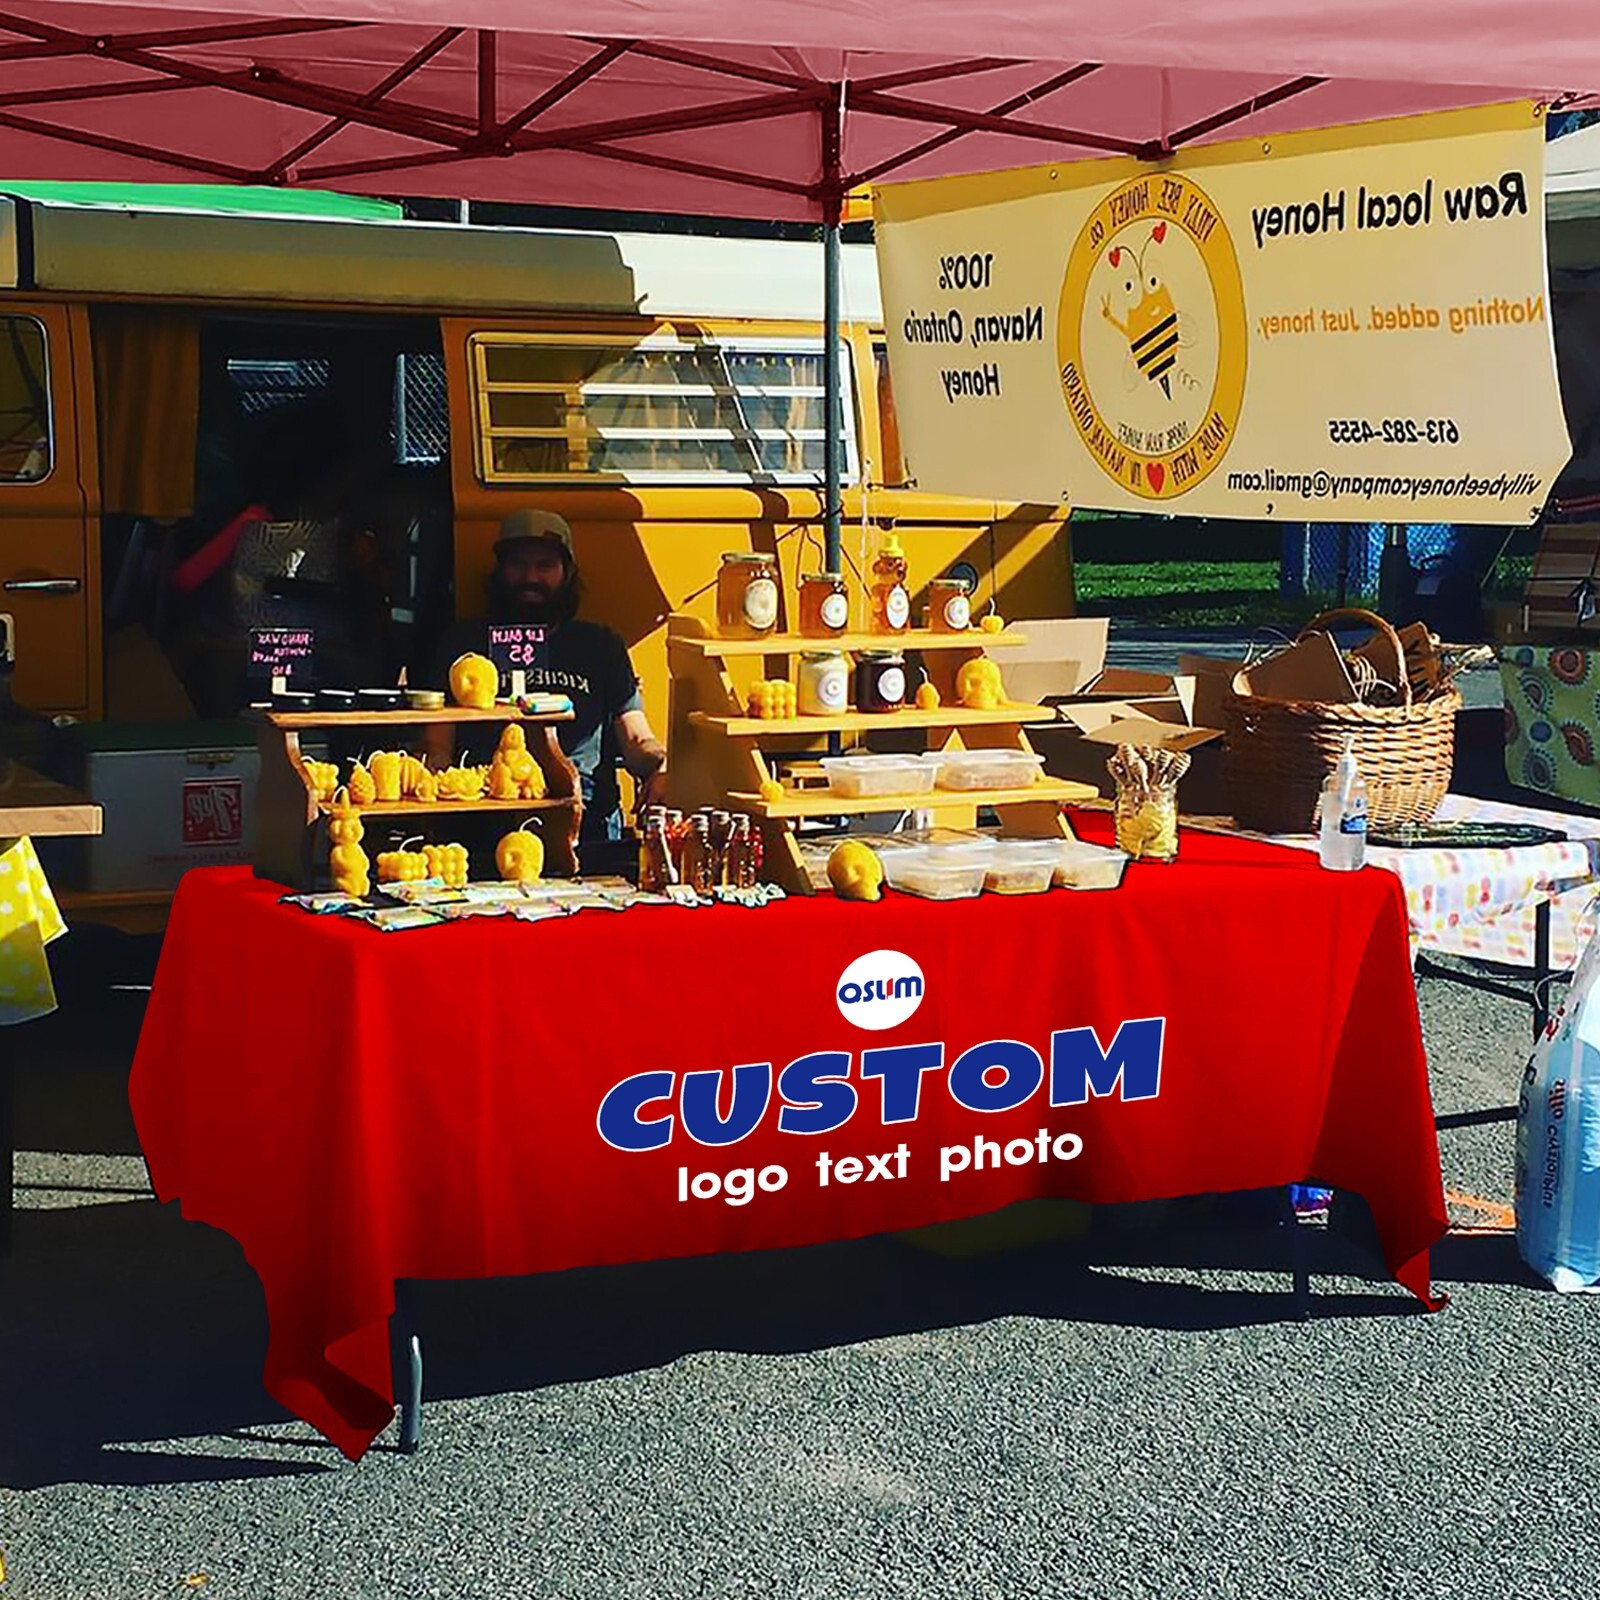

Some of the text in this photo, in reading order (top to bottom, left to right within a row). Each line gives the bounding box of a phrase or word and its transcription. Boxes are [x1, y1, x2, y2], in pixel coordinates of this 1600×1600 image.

[596, 1016, 1166, 1153] CUSTOM
[678, 1127, 1084, 1207] logo text photo
